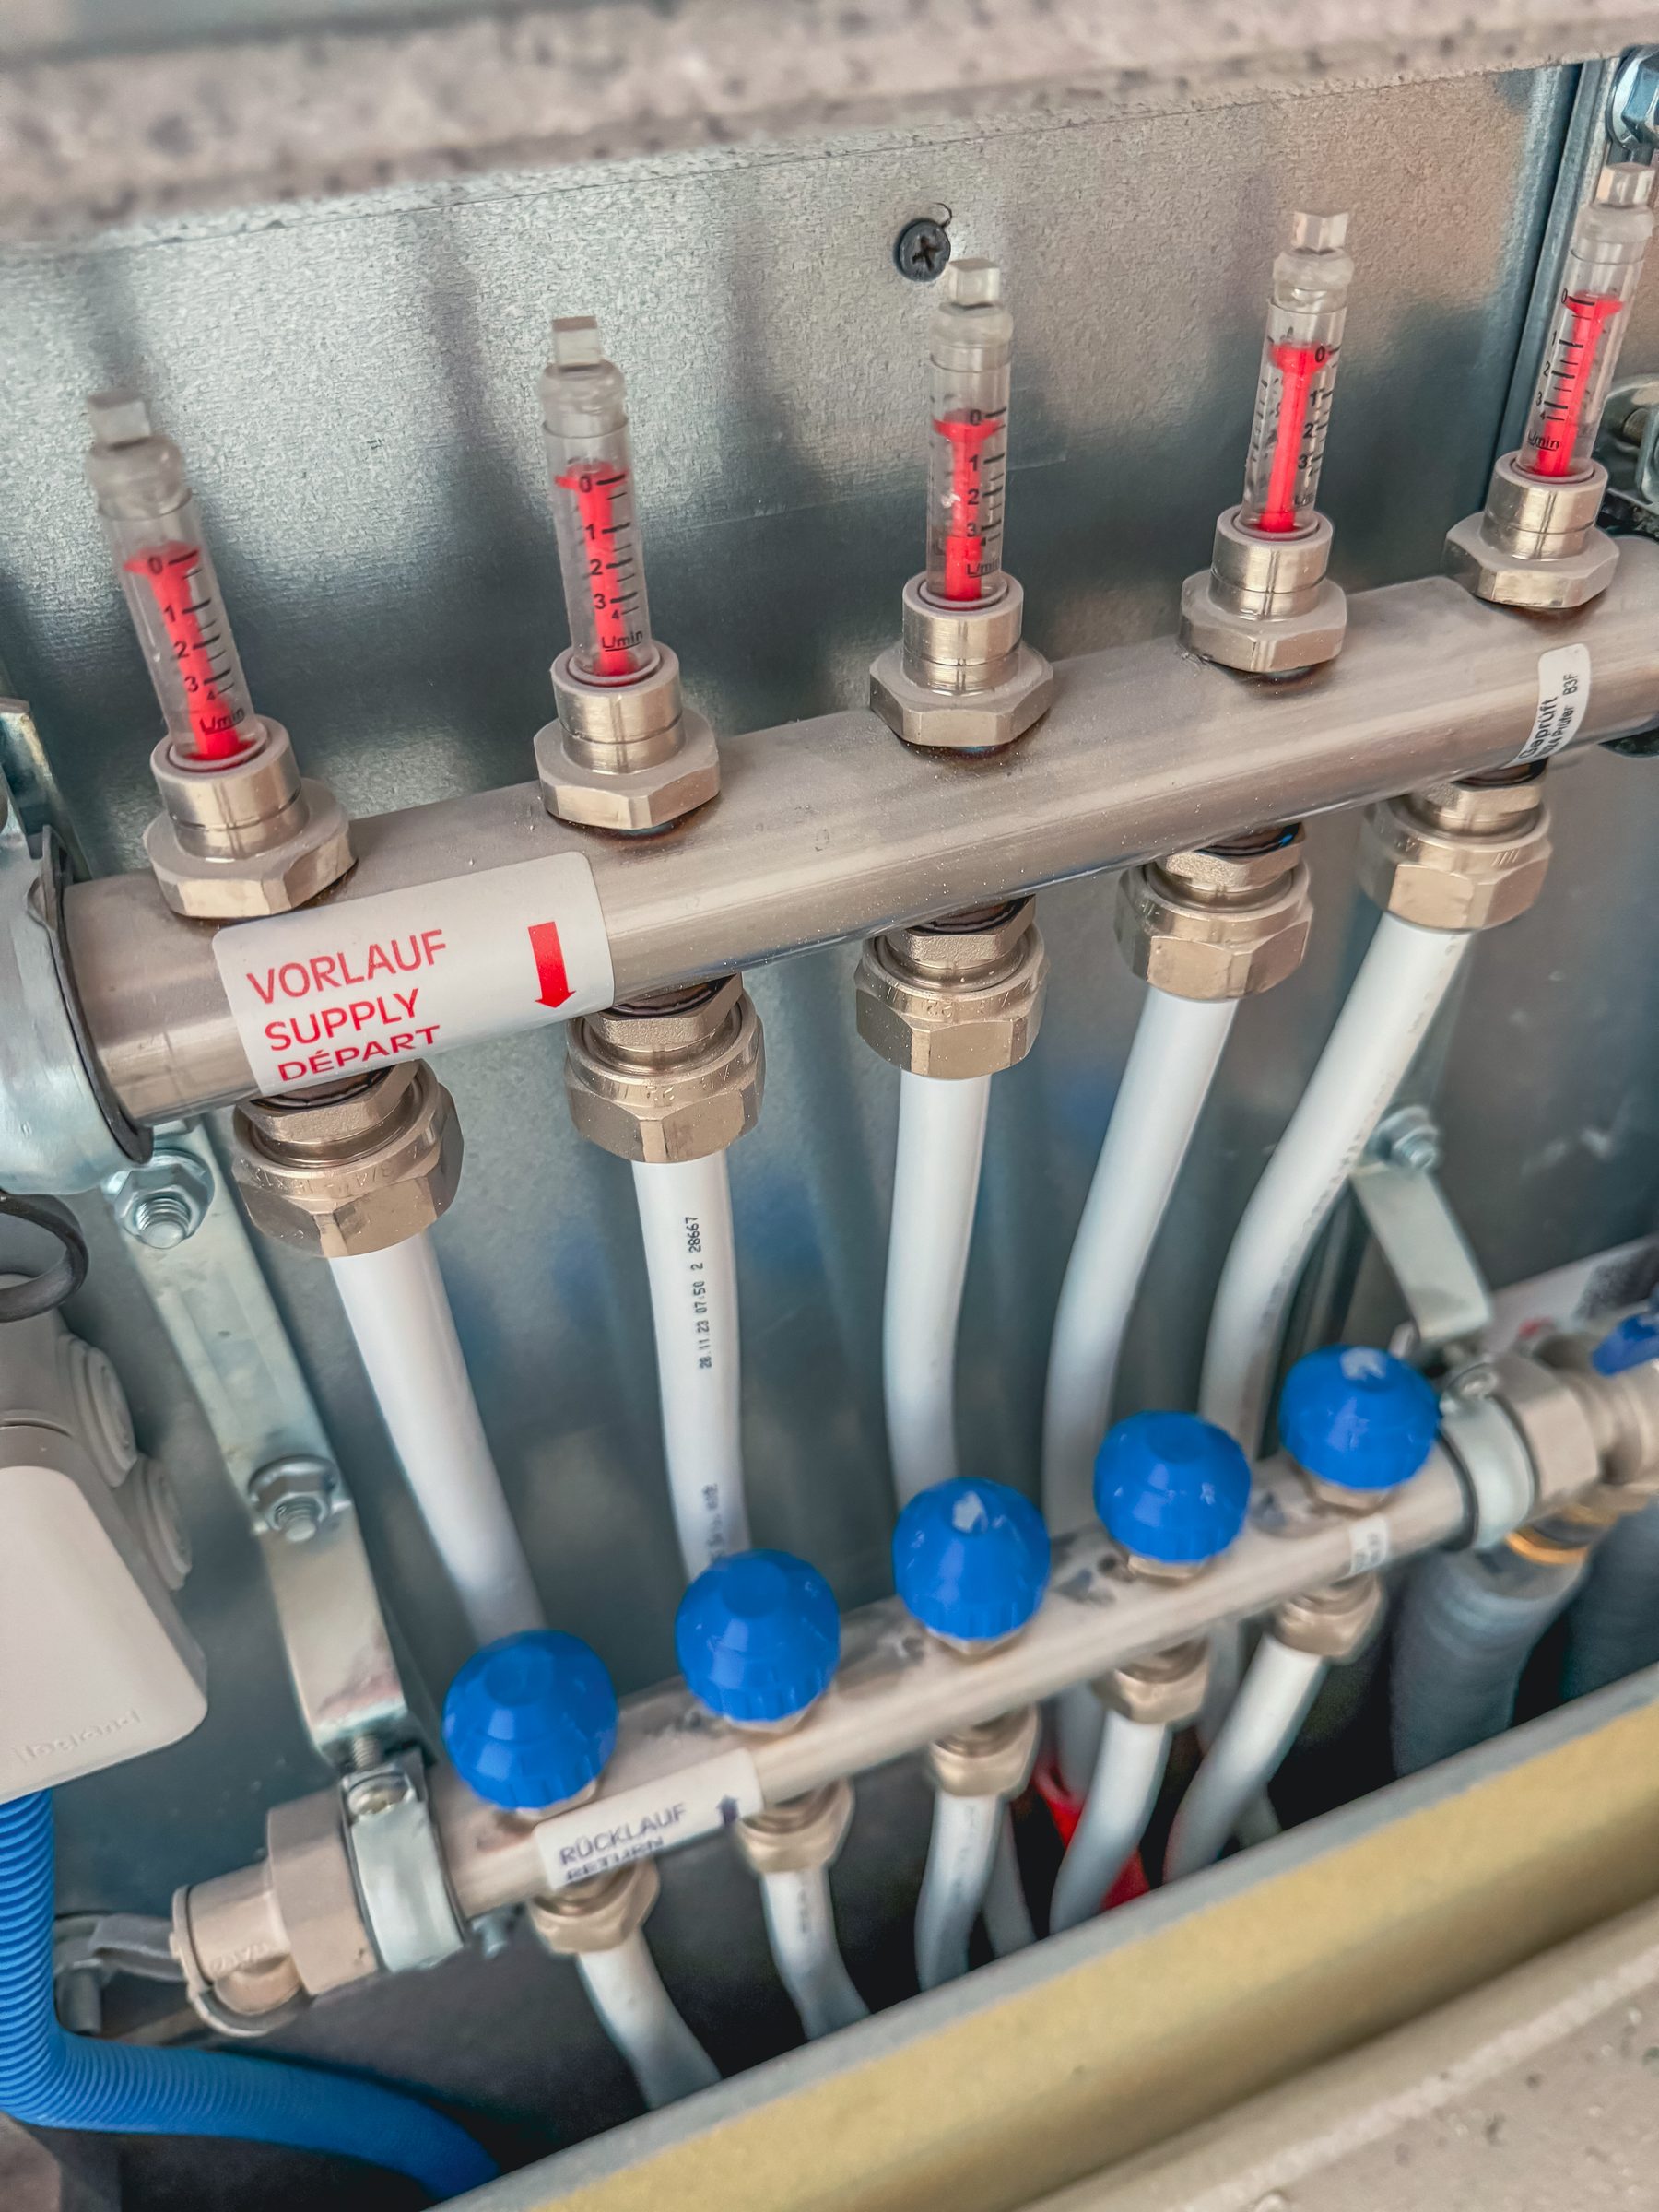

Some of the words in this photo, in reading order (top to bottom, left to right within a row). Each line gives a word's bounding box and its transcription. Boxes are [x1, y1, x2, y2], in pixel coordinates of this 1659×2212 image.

[1560, 288, 1569, 303] 0
[1551, 330, 1558, 347] 1
[1314, 345, 1326, 362] 0
[1543, 361, 1551, 378] 2
[1310, 390, 1319, 406] 1
[1535, 391, 1543, 406] 3
[970, 408, 982, 426] 0
[1302, 423, 1314, 439] 2
[969, 453, 979, 472] 1
[1297, 454, 1308, 470] 3
[579, 476, 593, 493] 0
[967, 488, 980, 505] 2
[585, 523, 595, 540] 1
[966, 522, 977, 537] 3
[147, 557, 162, 574] 0
[590, 558, 603, 575] 2
[594, 593, 606, 610] 3
[163, 605, 177, 623] 1
[611, 609, 620, 620] 4
[173, 641, 189, 659] 2
[184, 675, 199, 692] 3
[1562, 673, 1579, 696] B3F
[206, 691, 216, 701] 4
[1518, 695, 1558, 759] Geprüft
[1551, 706, 1574, 737] Prüfer
[246, 929, 446, 1005] VORLAUF
[265, 988, 419, 1052] SUPPLY
[277, 1025, 440, 1082] DÉPART
[685, 1216, 701, 1253] 28667
[559, 1802, 688, 1865] RÜCKLAUF
